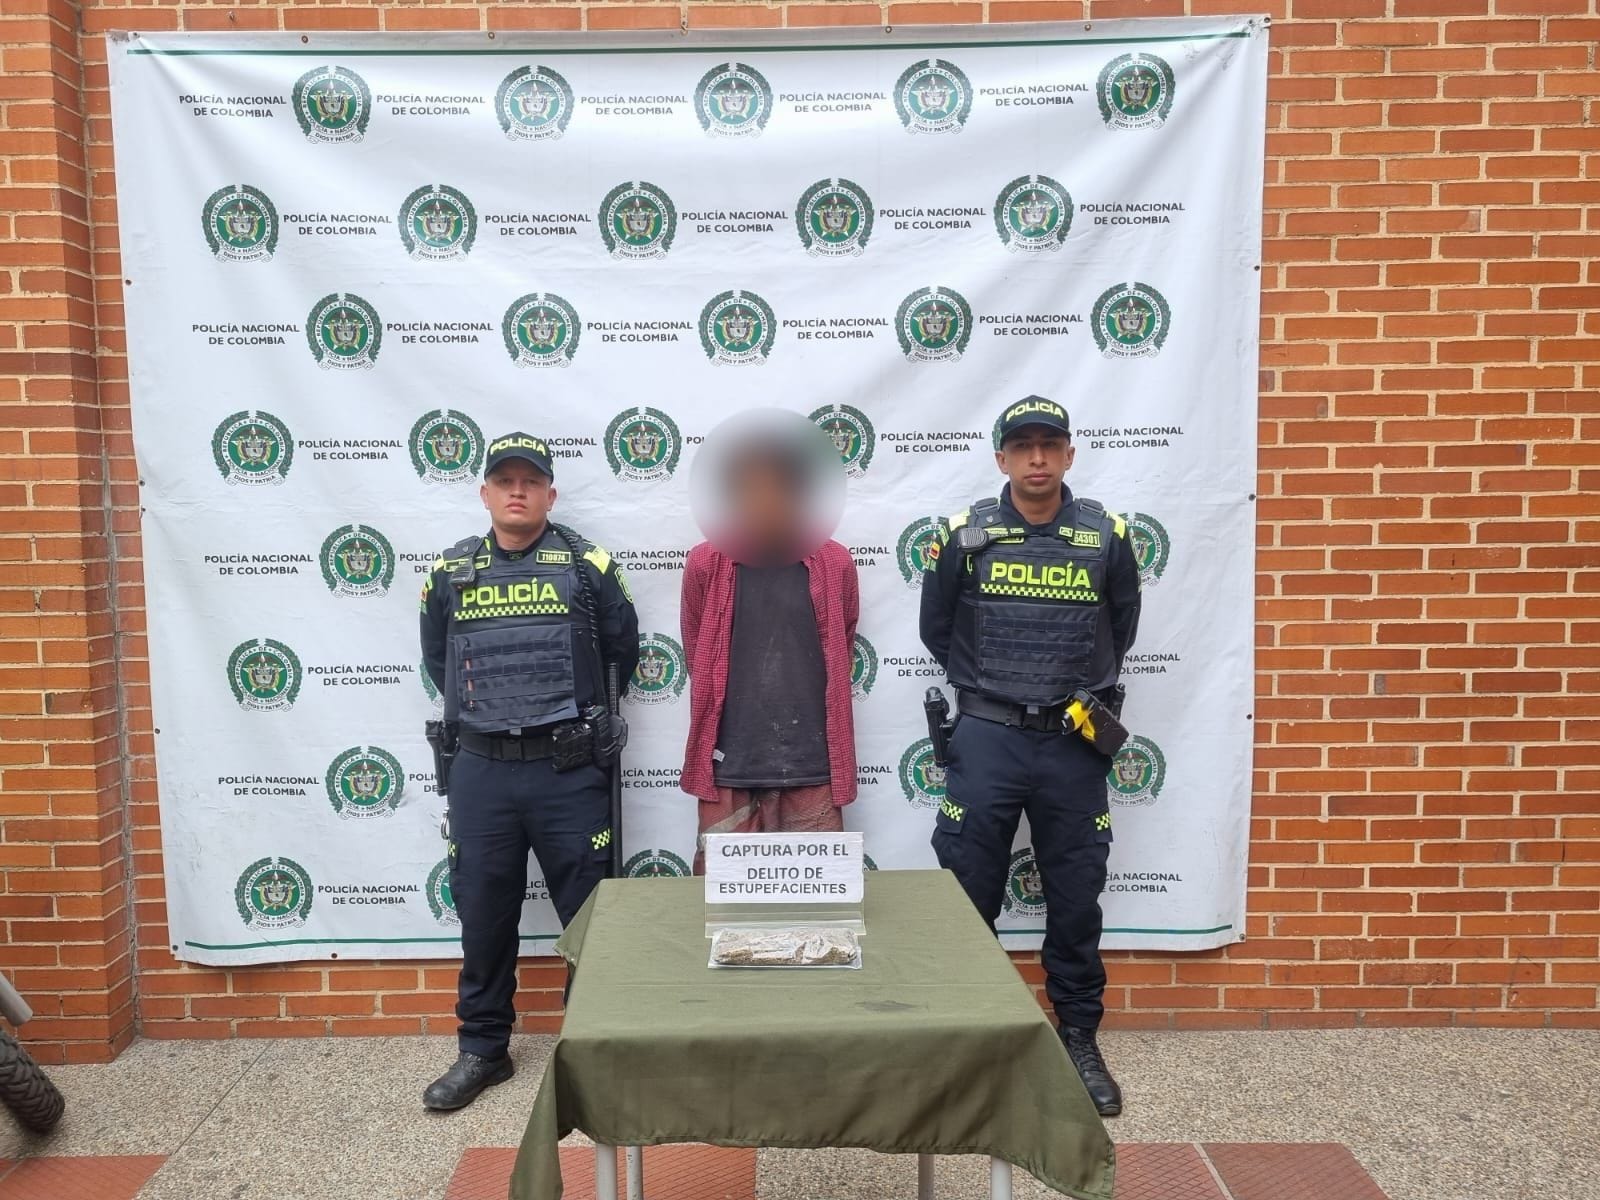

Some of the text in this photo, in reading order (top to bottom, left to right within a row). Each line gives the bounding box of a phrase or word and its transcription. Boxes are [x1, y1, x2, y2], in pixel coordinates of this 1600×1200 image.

[979, 83, 1089, 96] POLICÍA NACIONAL
[178, 94, 287, 106] POLICÍA NACIONAL
[376, 94, 486, 104] POLICÍA NACIONAL
[580, 95, 689, 105] POLICÍA NACIONAL
[779, 91, 887, 103] POLICÍA NACIONAL
[995, 95, 1075, 107] DE COLOMBIA
[193, 106, 274, 118] DE COLOMBIA
[391, 106, 471, 116] DE COLOMBIA
[595, 106, 674, 116] DE COLOMBIA
[794, 103, 873, 113] DE COLOMBIA
[879, 206, 987, 218] POLICÍA NACIONAL
[1079, 201, 1186, 213] POLICÍA NACIONAL
[282, 212, 393, 224] POLICÍA NACIONAL
[484, 212, 592, 224] POLICÍA NACIONAL
[681, 209, 789, 221] POLICÍA NACIONAL
[1093, 215, 1171, 226] DE COLOMBIA
[696, 223, 774, 234] DE COLOMBIA
[894, 220, 972, 230] DE COLOMBIA
[298, 226, 377, 236] DE COLOMBIA
[500, 226, 578, 236] DE COLOMBIA
[1142, 294, 1161, 323] COLOMBIA
[748, 302, 767, 332] COLOMBIA
[782, 316, 889, 328] POLICÍA NACIONAL
[979, 313, 1084, 324] POLICÍA NACIONAL
[191, 322, 300, 334] POLICÍA NACIONAL
[386, 320, 494, 332] POLICÍA NACIONAL
[586, 320, 694, 331] POLICÍA NACIONAL
[993, 326, 1069, 336] DE COLOMBIA
[401, 334, 480, 344] DE COLOMBIA
[601, 333, 679, 343] DE COLOMBIA
[797, 329, 875, 340] DE COLOMBIA
[1131, 330, 1158, 349] NACIONAL
[208, 336, 286, 346] DE COLOMBIA
[264, 422, 285, 452] COLOMBIA
[880, 430, 985, 442] POLICÍA NACIONAL
[1076, 426, 1185, 438] POLICÍA NACIONAL
[298, 438, 404, 449] POLICÍA NACIONAL
[895, 443, 971, 453] DE COLOMBIA
[1090, 438, 1170, 450] DE COLOMBIA
[312, 451, 389, 461] DE COLOMBIA
[550, 450, 583, 458] OMBIA
[254, 459, 282, 476] NACIONAL
[848, 546, 891, 554] CIONAL
[204, 553, 314, 564] POLICÍA NACIONAL
[219, 566, 299, 576] DE COLOMBIA
[414, 565, 429, 573] DE
[626, 562, 685, 571] COLOMBIA
[990, 561, 1092, 589] POLICÍA
[462, 577, 559, 607] POLICÍA
[883, 655, 927, 665] POLICÍA
[1125, 653, 1181, 663] NACIONAL
[307, 663, 415, 675] POLICÍA NACIONAL
[898, 669, 912, 677] DE
[1119, 665, 1167, 675] OLOMBIA
[323, 676, 401, 686] DE COLOMBIA
[376, 757, 396, 785] COLOMBIA
[621, 768, 644, 777] ICÍA
[857, 765, 893, 773] IONAL
[217, 773, 320, 785] POLICÍA NACIONAL
[409, 773, 437, 781] POLI
[633, 780, 680, 788] COLOMB
[233, 787, 307, 797] DE COLOMBIA
[366, 792, 393, 810] NACIONAL
[722, 844, 848, 857] CAPTURA POR EL
[747, 867, 823, 880] DELITO DE
[1123, 872, 1183, 882] NACIONAL
[317, 884, 421, 894] POLICÍA NACIONAL
[719, 883, 847, 894] ESTUPEFACIENTES
[1108, 884, 1168, 893] COLOMBIA
[332, 896, 406, 905] DE COLOMBIA
